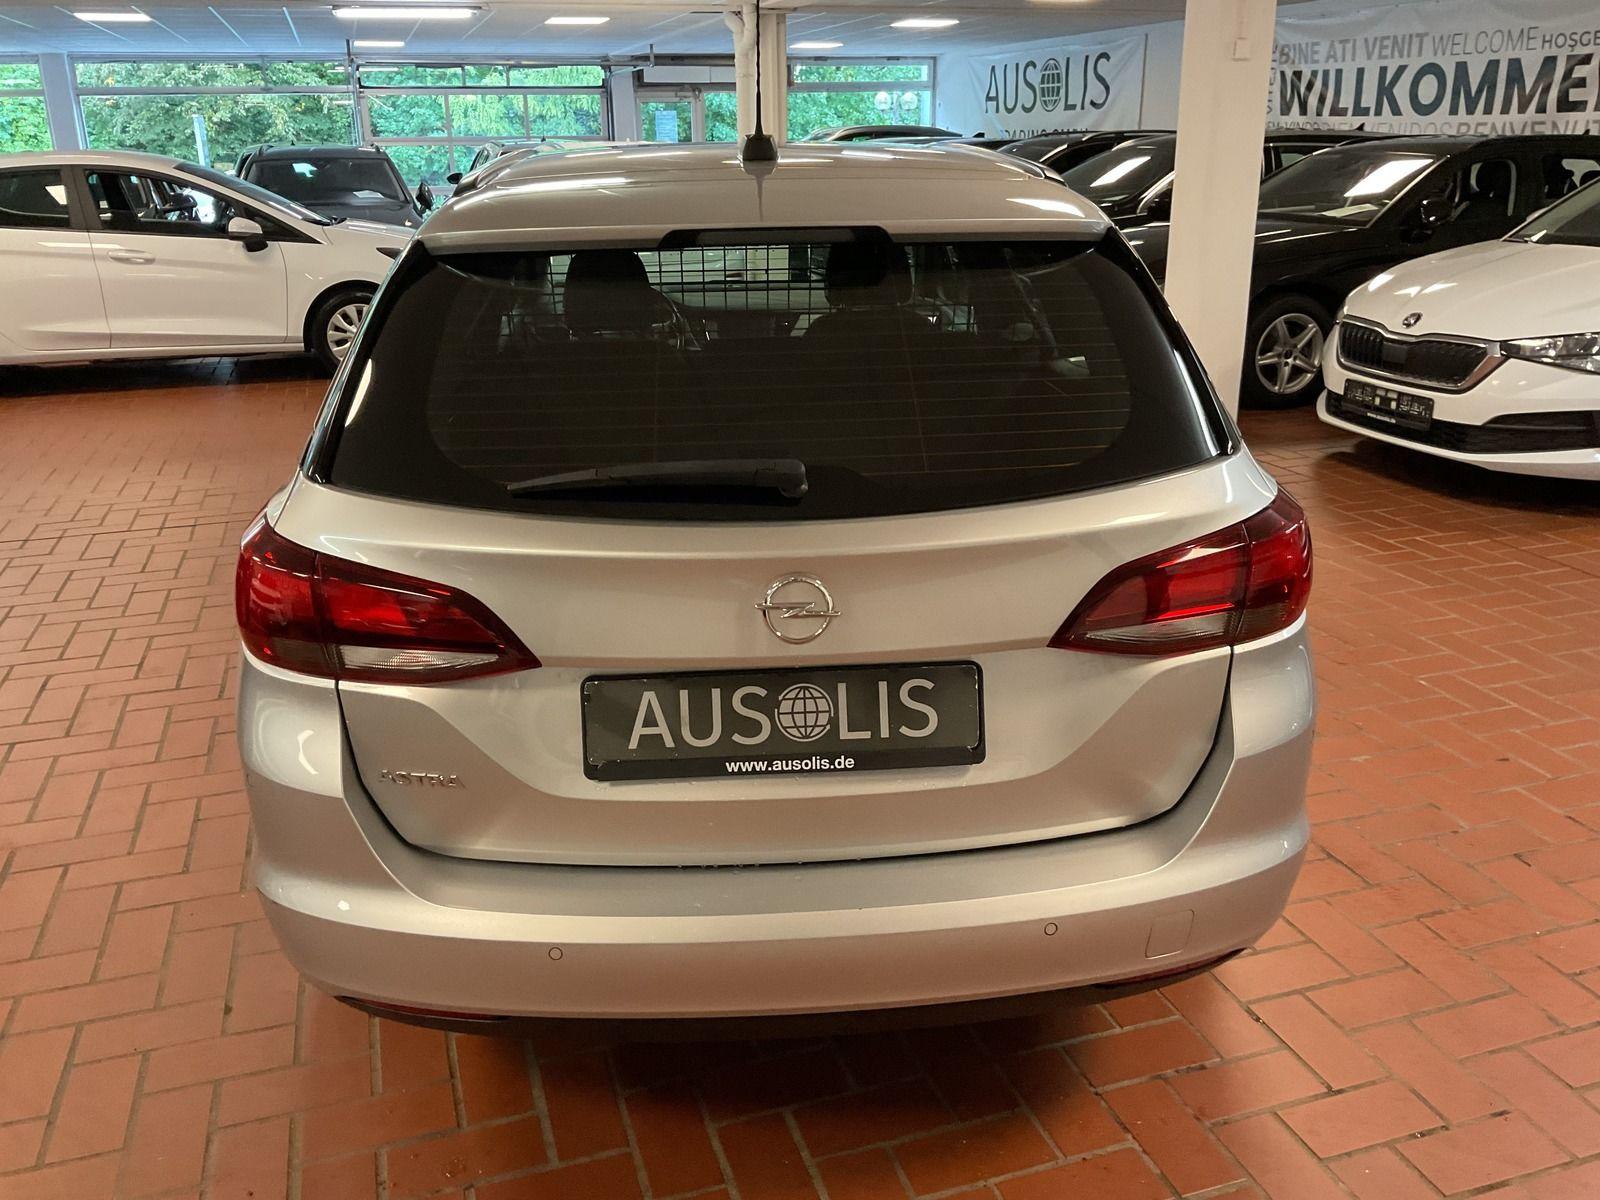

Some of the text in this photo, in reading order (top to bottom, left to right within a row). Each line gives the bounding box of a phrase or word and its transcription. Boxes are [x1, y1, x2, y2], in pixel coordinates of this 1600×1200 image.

[1279, 41, 1320, 65] BINE
[1364, 33, 1430, 61] VENIT
[1432, 26, 1539, 57] WELCOME
[985, 51, 1112, 115] AUSOLIS
[1278, 53, 1600, 117] WILLKOMME
[628, 678, 939, 750] AUSOLIS
[725, 755, 855, 773] www.ausolis.de
